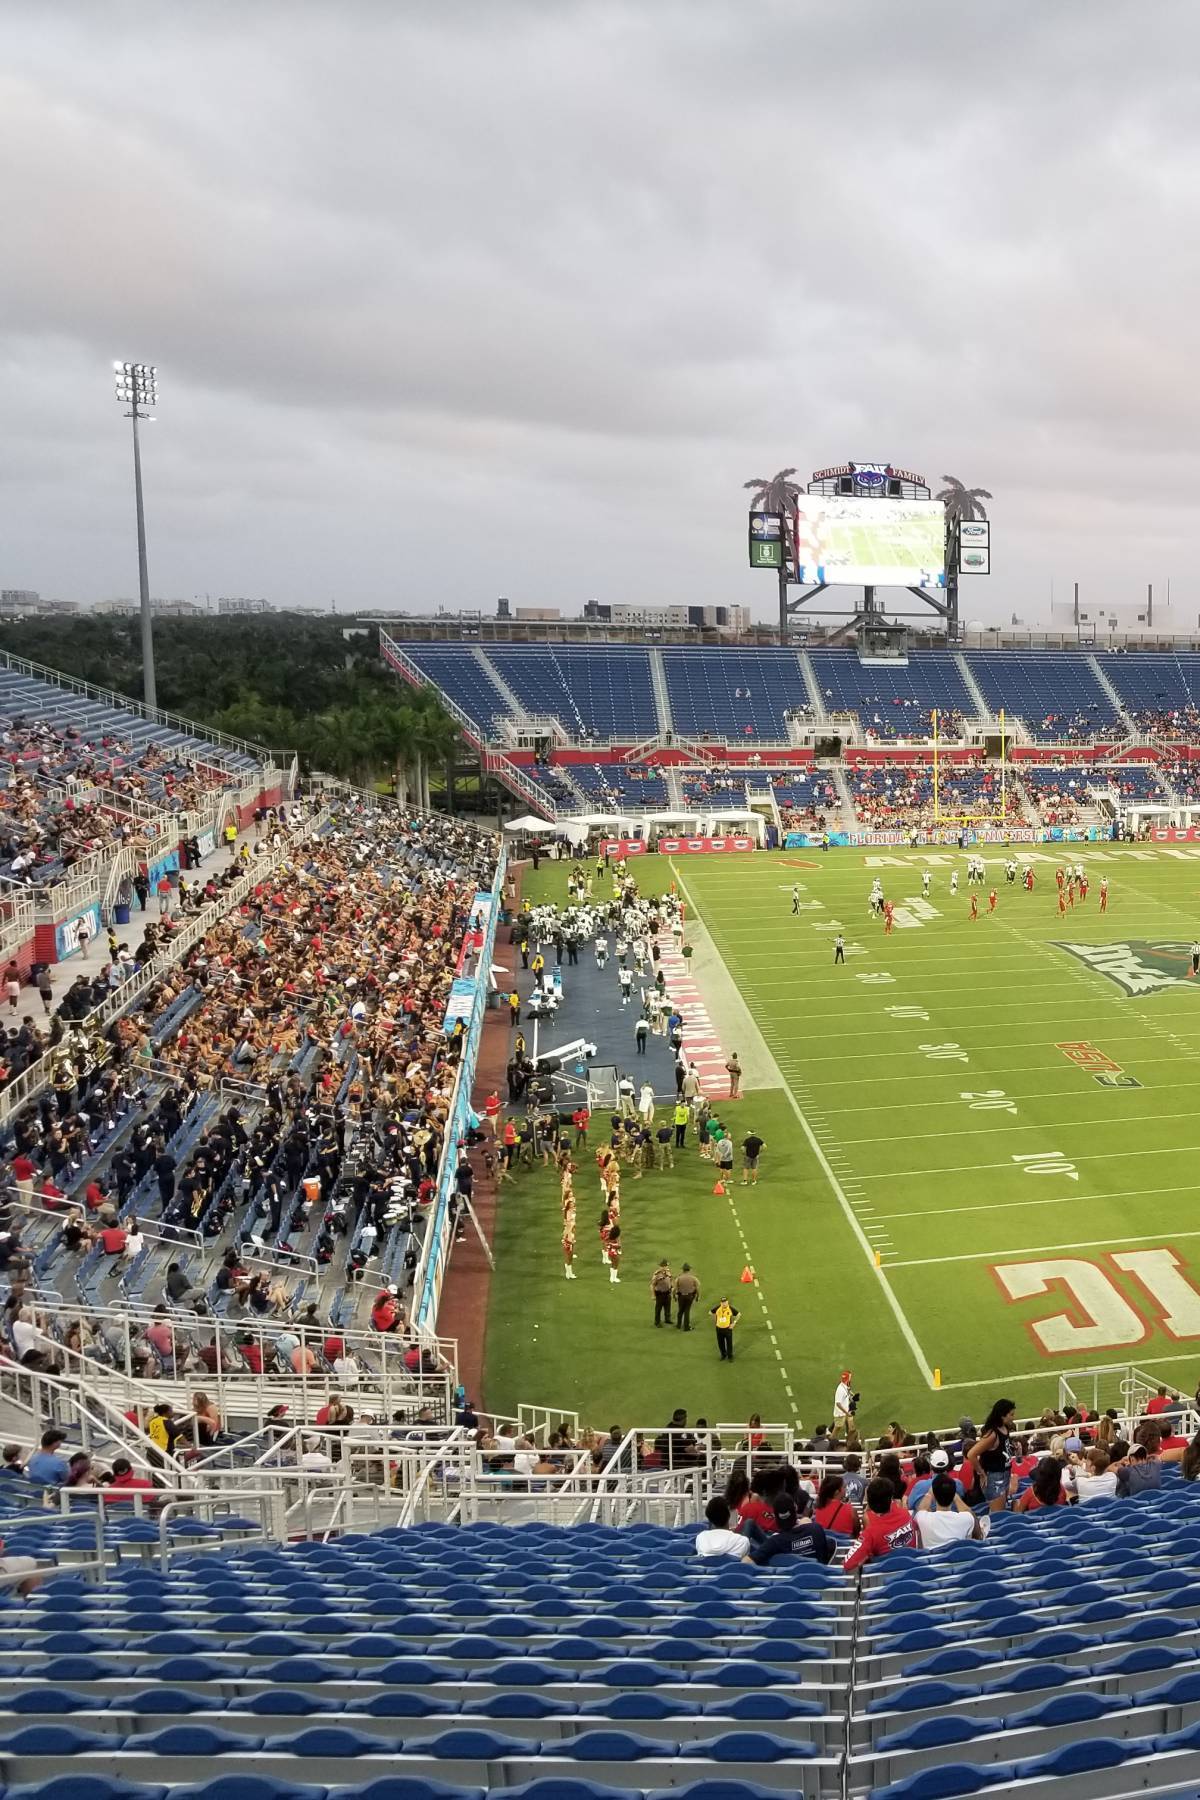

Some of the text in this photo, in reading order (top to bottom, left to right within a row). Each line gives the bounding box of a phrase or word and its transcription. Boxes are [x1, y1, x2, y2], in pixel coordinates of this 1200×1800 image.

[814, 465, 850, 480] SCHMIDT
[853, 463, 888, 475] FAU
[892, 467, 926, 484] FAMILY
[849, 831, 905, 845] FLORIDA
[856, 972, 896, 983] 50
[918, 1043, 965, 1060] 30
[959, 1089, 1016, 1111] 20
[1011, 1150, 1076, 1175] 10
[885, 1523, 913, 1542] FAU
[793, 1537, 811, 1549] Hilton
